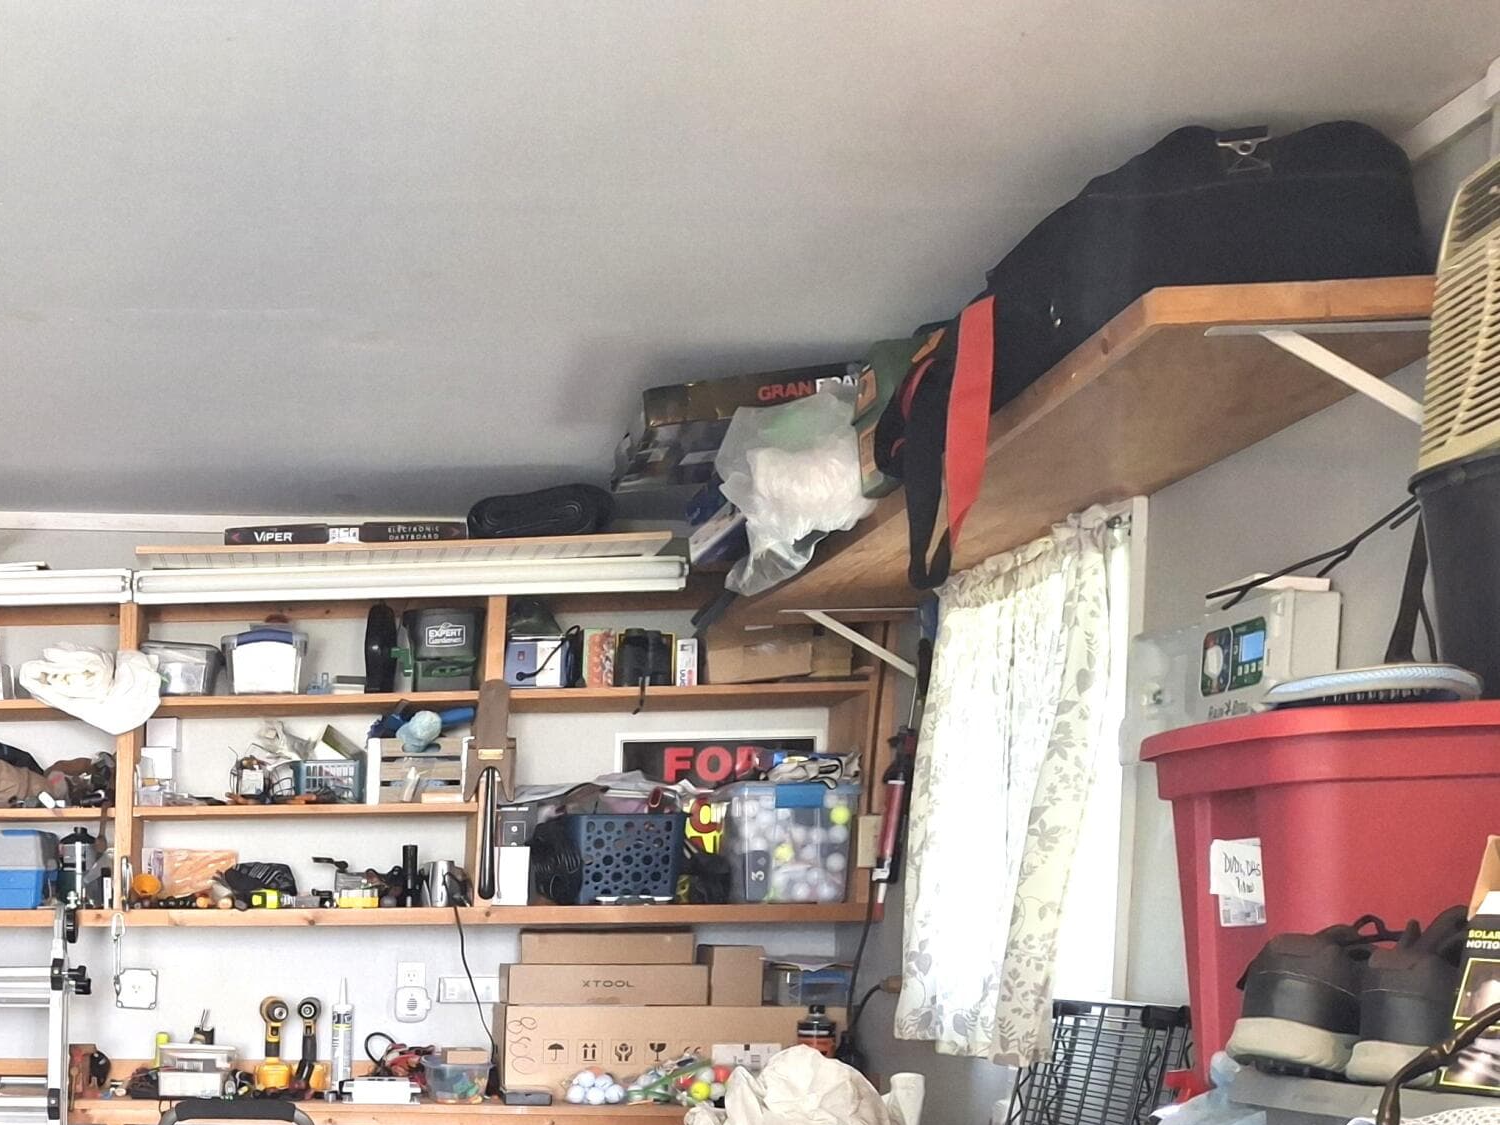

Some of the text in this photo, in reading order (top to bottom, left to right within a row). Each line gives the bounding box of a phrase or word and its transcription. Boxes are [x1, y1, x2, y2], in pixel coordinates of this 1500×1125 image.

[428, 627, 463, 638] EXPERT
[1465, 940, 1500, 950] MOTIO
[582, 979, 635, 989] XTOOL
